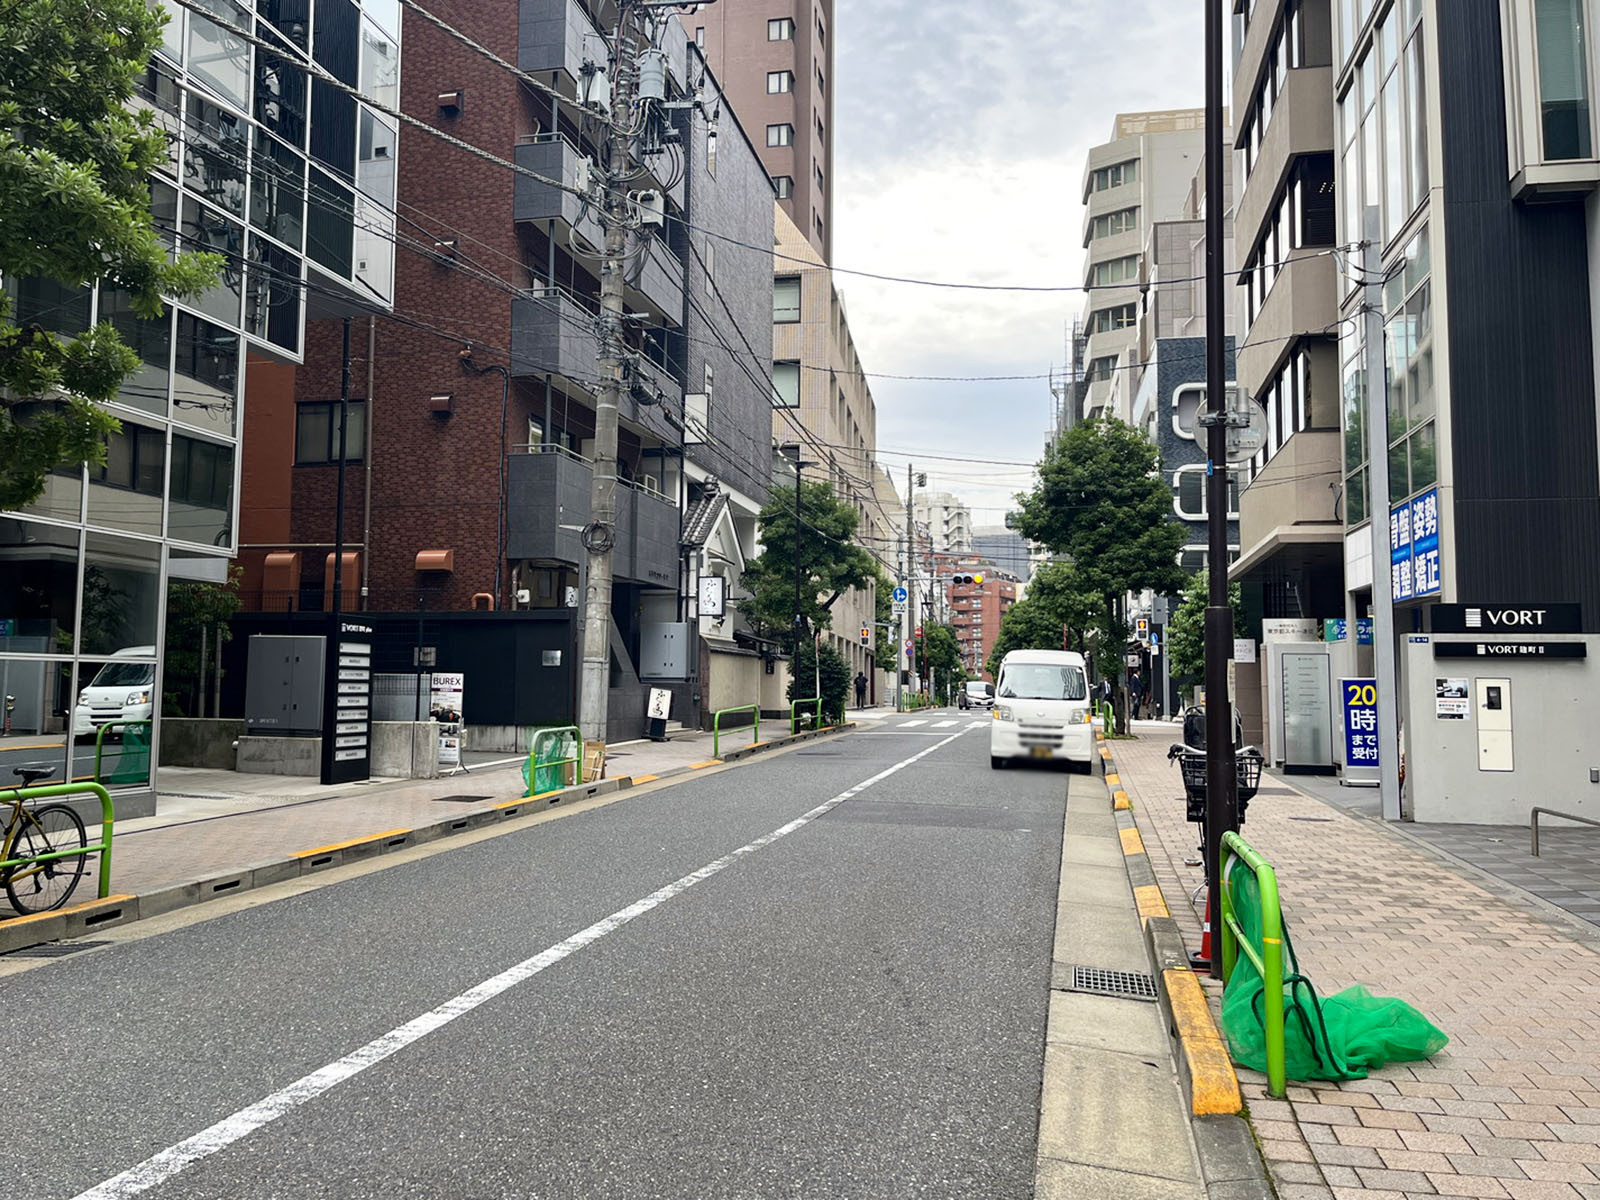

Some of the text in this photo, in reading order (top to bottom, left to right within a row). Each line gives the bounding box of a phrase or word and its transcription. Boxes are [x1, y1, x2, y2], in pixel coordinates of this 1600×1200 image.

[1413, 494, 1437, 541] 姿勢
[1391, 508, 1410, 549] 骨盤
[1415, 550, 1440, 593] 矯正
[1487, 610, 1547, 626] VORT
[1488, 645, 1518, 654] VORT
[433, 676, 462, 686] BUREX
[1348, 685, 1377, 706] 20
[1350, 709, 1376, 731] 時
[1352, 735, 1377, 746] まで
[1352, 747, 1378, 760] 受付
